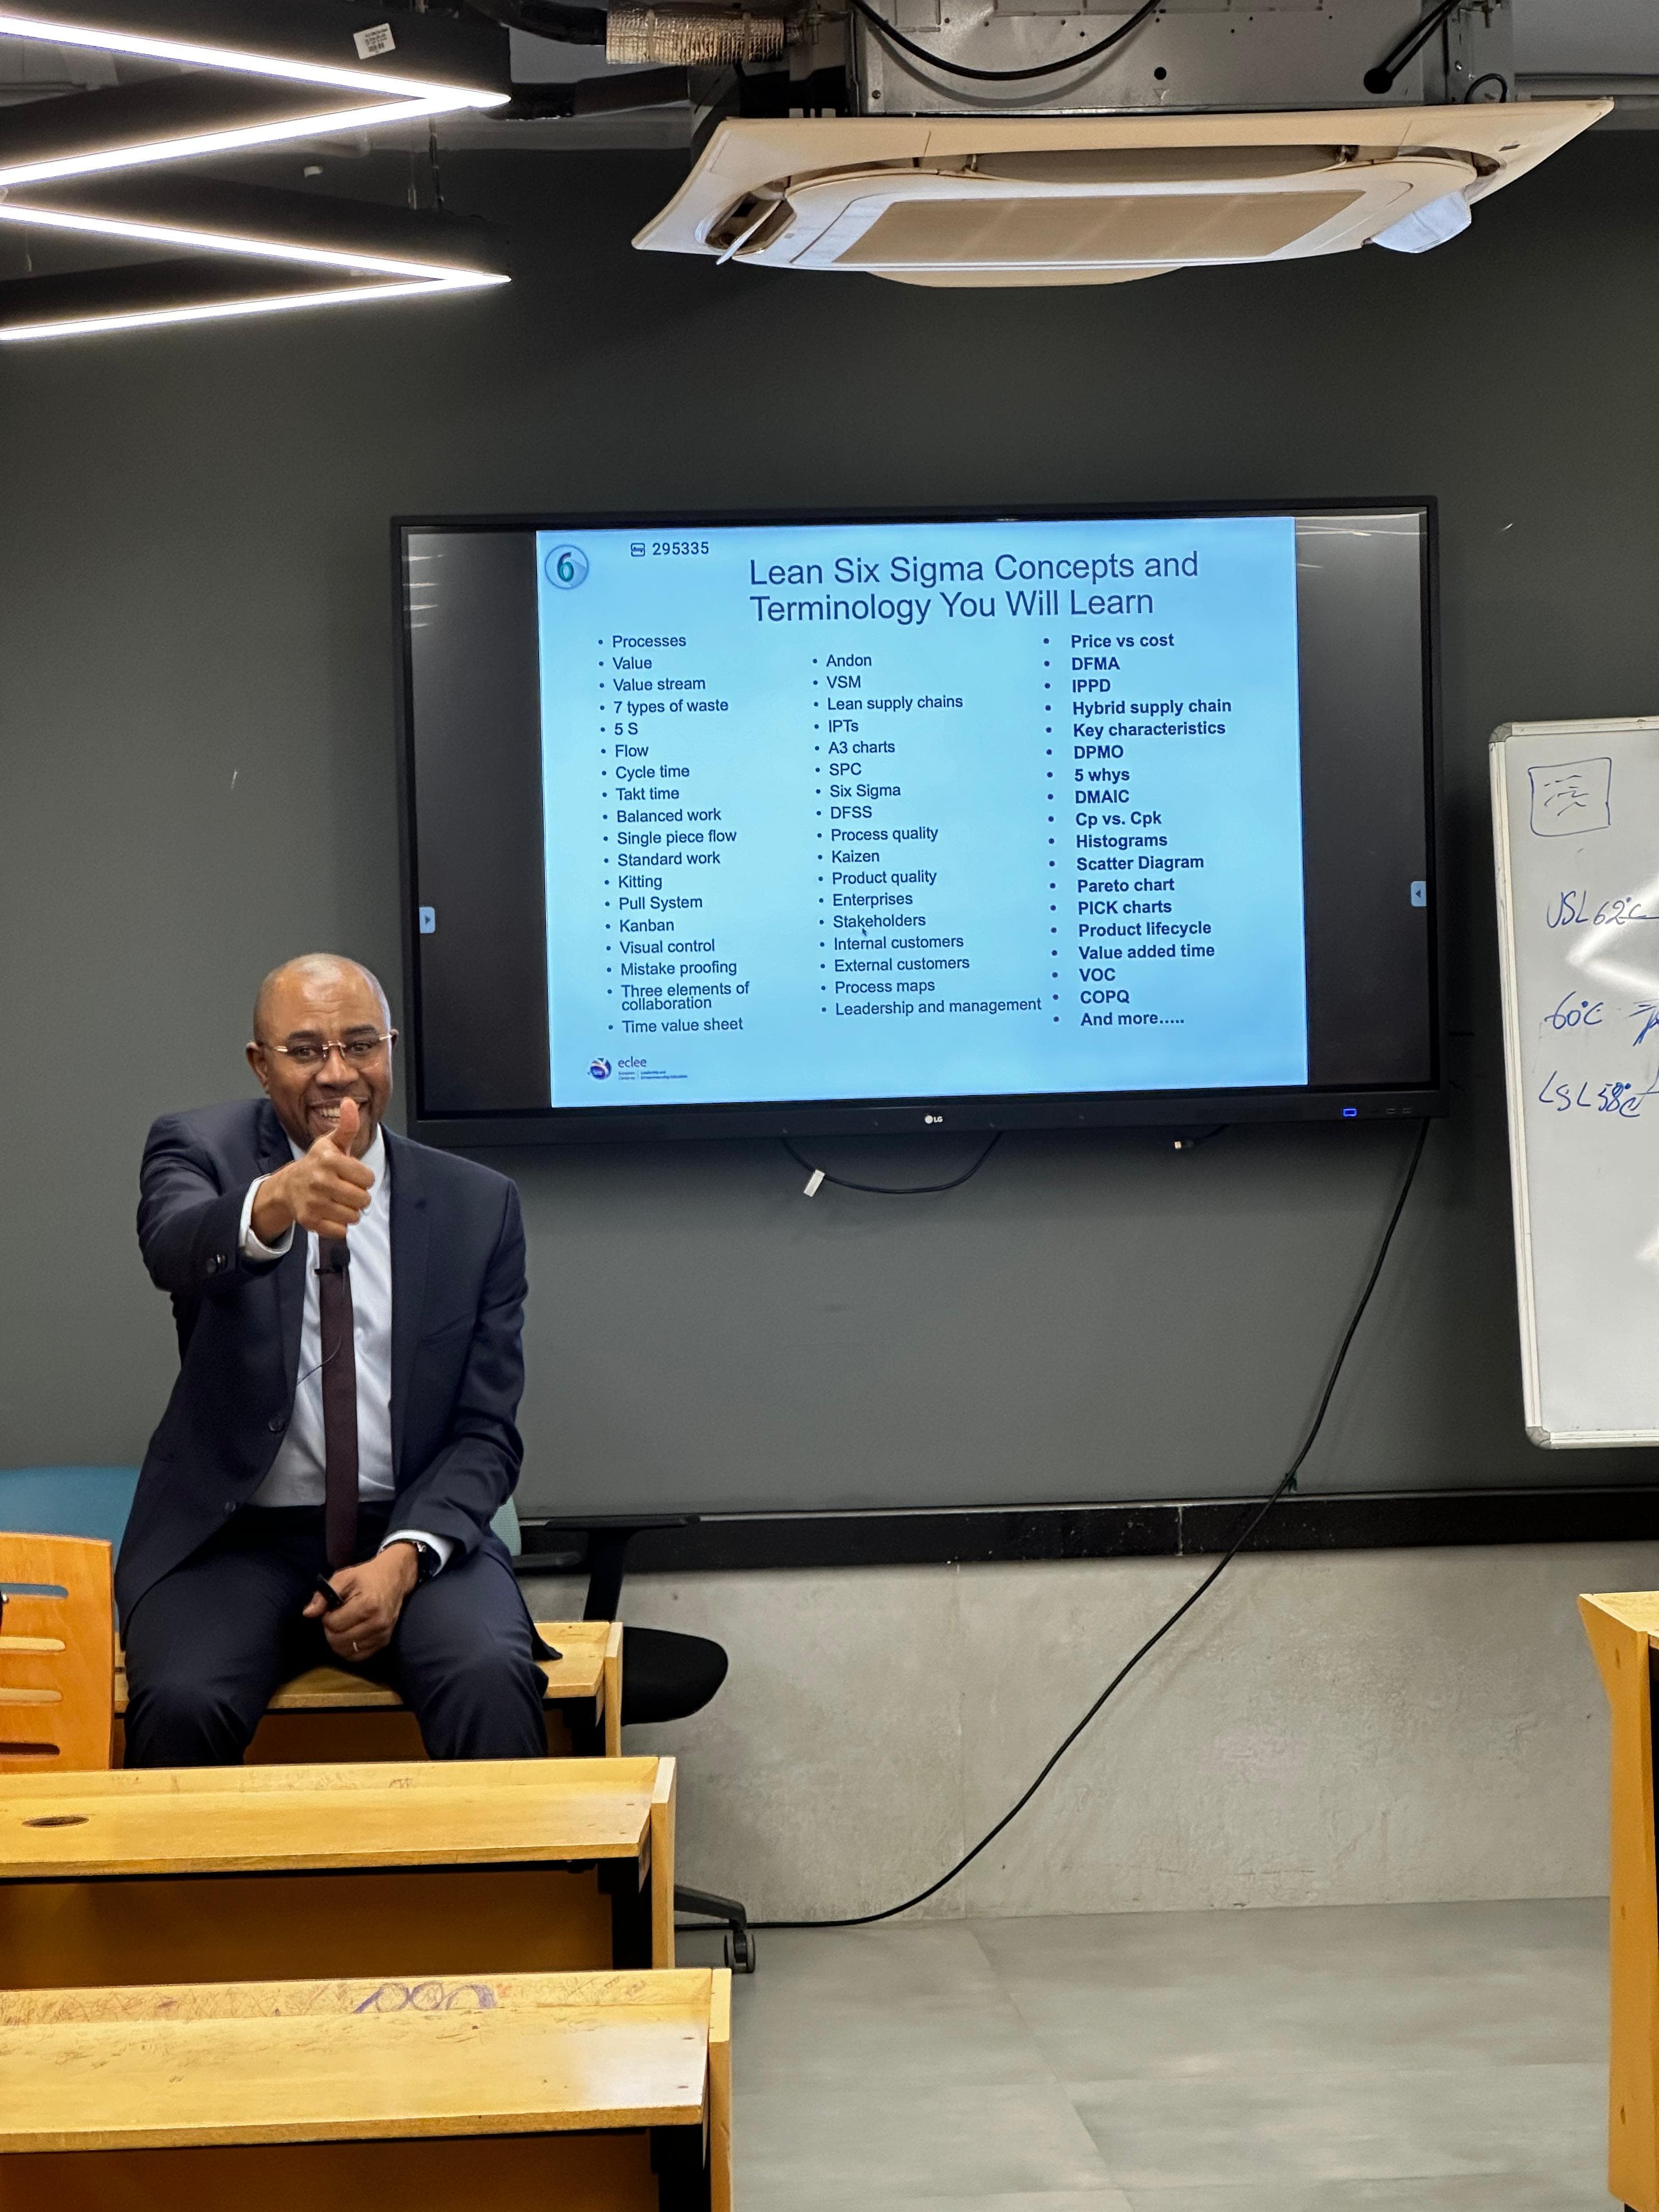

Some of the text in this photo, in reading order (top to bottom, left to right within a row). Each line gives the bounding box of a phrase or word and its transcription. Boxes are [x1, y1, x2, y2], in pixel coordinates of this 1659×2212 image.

[652, 541, 709, 555] 295335
[556, 551, 574, 582] 6
[751, 551, 1198, 588] Lean Six Sigma Concepts and
[750, 590, 1153, 625] Terminology You Will Learn
[613, 635, 686, 648] Processes
[1071, 634, 1174, 648] Price vs cost
[612, 656, 652, 669] Value
[826, 654, 872, 667] Andon
[1072, 657, 1120, 670] DFMA
[613, 678, 705, 691] Value stream
[826, 675, 861, 689] VSM
[1073, 679, 1110, 693] IPPD
[614, 699, 728, 716] 7 types of waste
[828, 695, 963, 712] Lean supply chains
[1073, 699, 1231, 718] Hybrid supply chain
[614, 723, 638, 735] 5 S
[829, 719, 859, 733] IPTs
[1074, 721, 1225, 740] Key characteristics
[616, 744, 648, 757] Flow
[828, 741, 895, 754] A3 charts
[1074, 745, 1124, 759] DPMO
[616, 765, 690, 782] Cycle time
[830, 763, 861, 776] SPC
[1075, 768, 1130, 784] 5 whys
[616, 787, 679, 800] Takt time
[830, 784, 901, 799] Six Sigma
[1075, 789, 1129, 803] DMAIC
[617, 808, 721, 822] Balanced work
[831, 806, 872, 819] DFSS
[1076, 811, 1162, 828] Cp vs. Cpk
[617, 830, 737, 847] Single piece flow
[832, 826, 938, 843] Process quality
[1076, 834, 1167, 850] Histograms
[618, 851, 720, 866] Standard work
[832, 850, 879, 863] Kaizen
[1077, 856, 1204, 872] Scatter Diagram
[619, 875, 662, 890] Kitting
[833, 870, 937, 886] Product quality
[1078, 878, 1175, 893] Pareto chart
[619, 896, 702, 912] Pull System
[833, 892, 913, 909] Enterprises
[1079, 900, 1172, 915] PICK charts
[620, 918, 674, 932] Kanban
[834, 914, 926, 928] Stakeholders
[1079, 921, 1211, 938] Product lifecycle
[620, 938, 714, 953] Visual control
[834, 936, 963, 950] Internal customers
[1079, 944, 1215, 960] Value added time
[622, 961, 736, 978] Mistake proofing
[835, 957, 970, 972] External customers
[1079, 968, 1115, 981] VOC
[621, 981, 749, 997] Three elements of
[836, 981, 935, 995] Process maps
[622, 996, 712, 1011] collaboration
[1081, 990, 1130, 1003] COPQ
[836, 998, 1042, 1017] Leadership and management
[622, 1017, 743, 1033] Time value sheet
[1081, 1012, 1113, 1026] And
[618, 1056, 647, 1068] eclee
